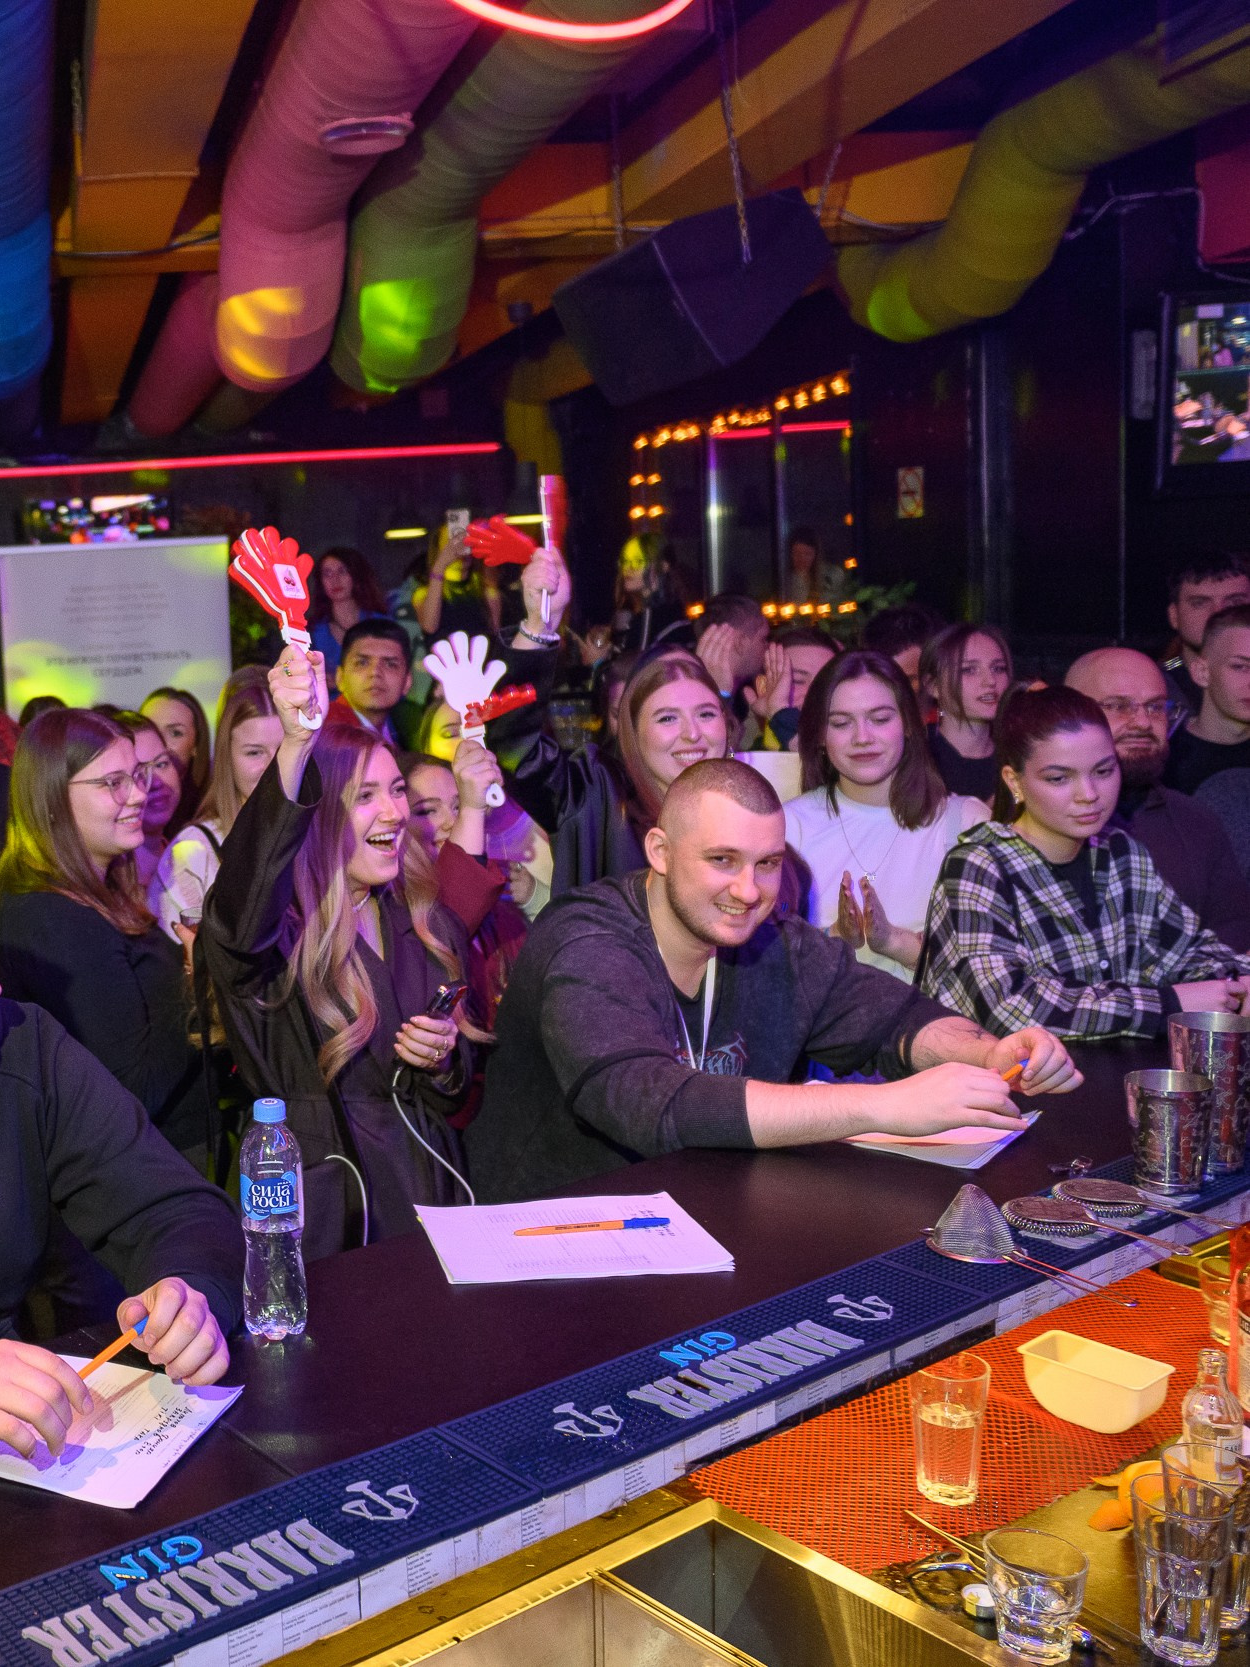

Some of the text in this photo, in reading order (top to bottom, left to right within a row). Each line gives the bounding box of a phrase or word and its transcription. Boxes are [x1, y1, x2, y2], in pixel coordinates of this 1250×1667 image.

[626, 1319, 866, 1420] BARRISTER
[658, 1331, 737, 1368] GIN
[21, 1518, 355, 1667] BARRISTER
[100, 1535, 204, 1590] GIN
